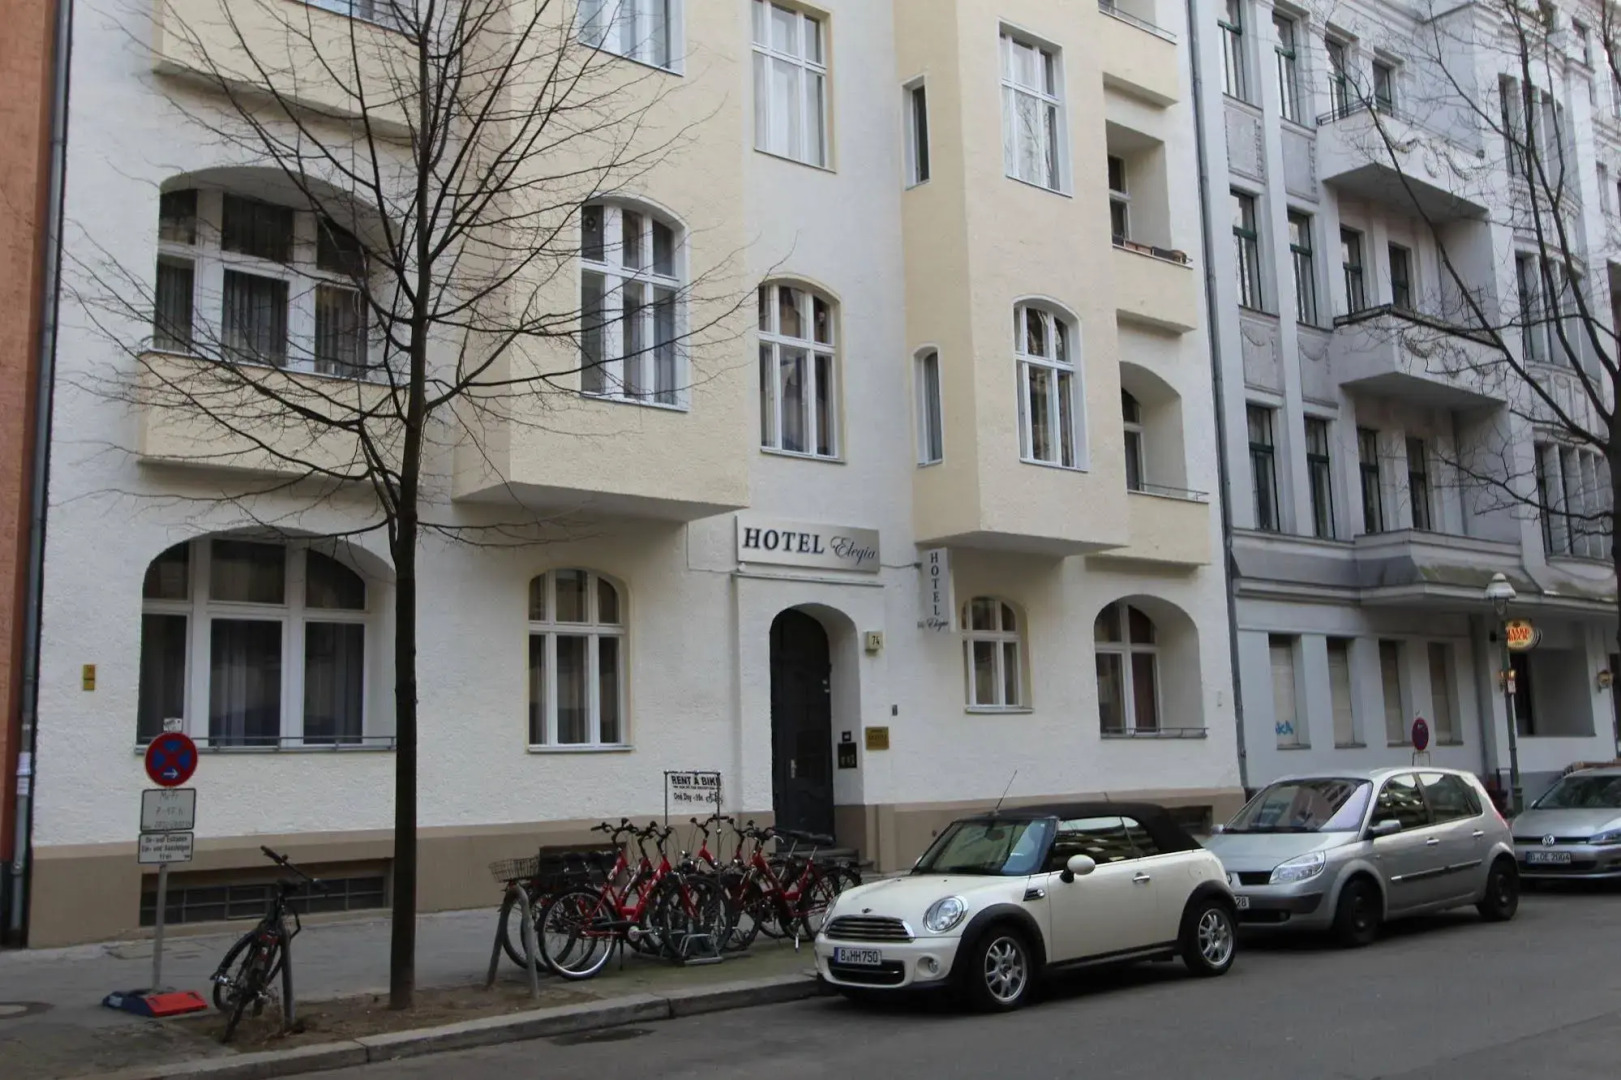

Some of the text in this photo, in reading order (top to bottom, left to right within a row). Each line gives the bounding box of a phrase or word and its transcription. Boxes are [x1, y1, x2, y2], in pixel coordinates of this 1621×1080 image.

[742, 527, 876, 565] HOTEL Elegia
[930, 551, 940, 616] HOTEL
[671, 775, 691, 785] RENT
[694, 776, 700, 785] A
